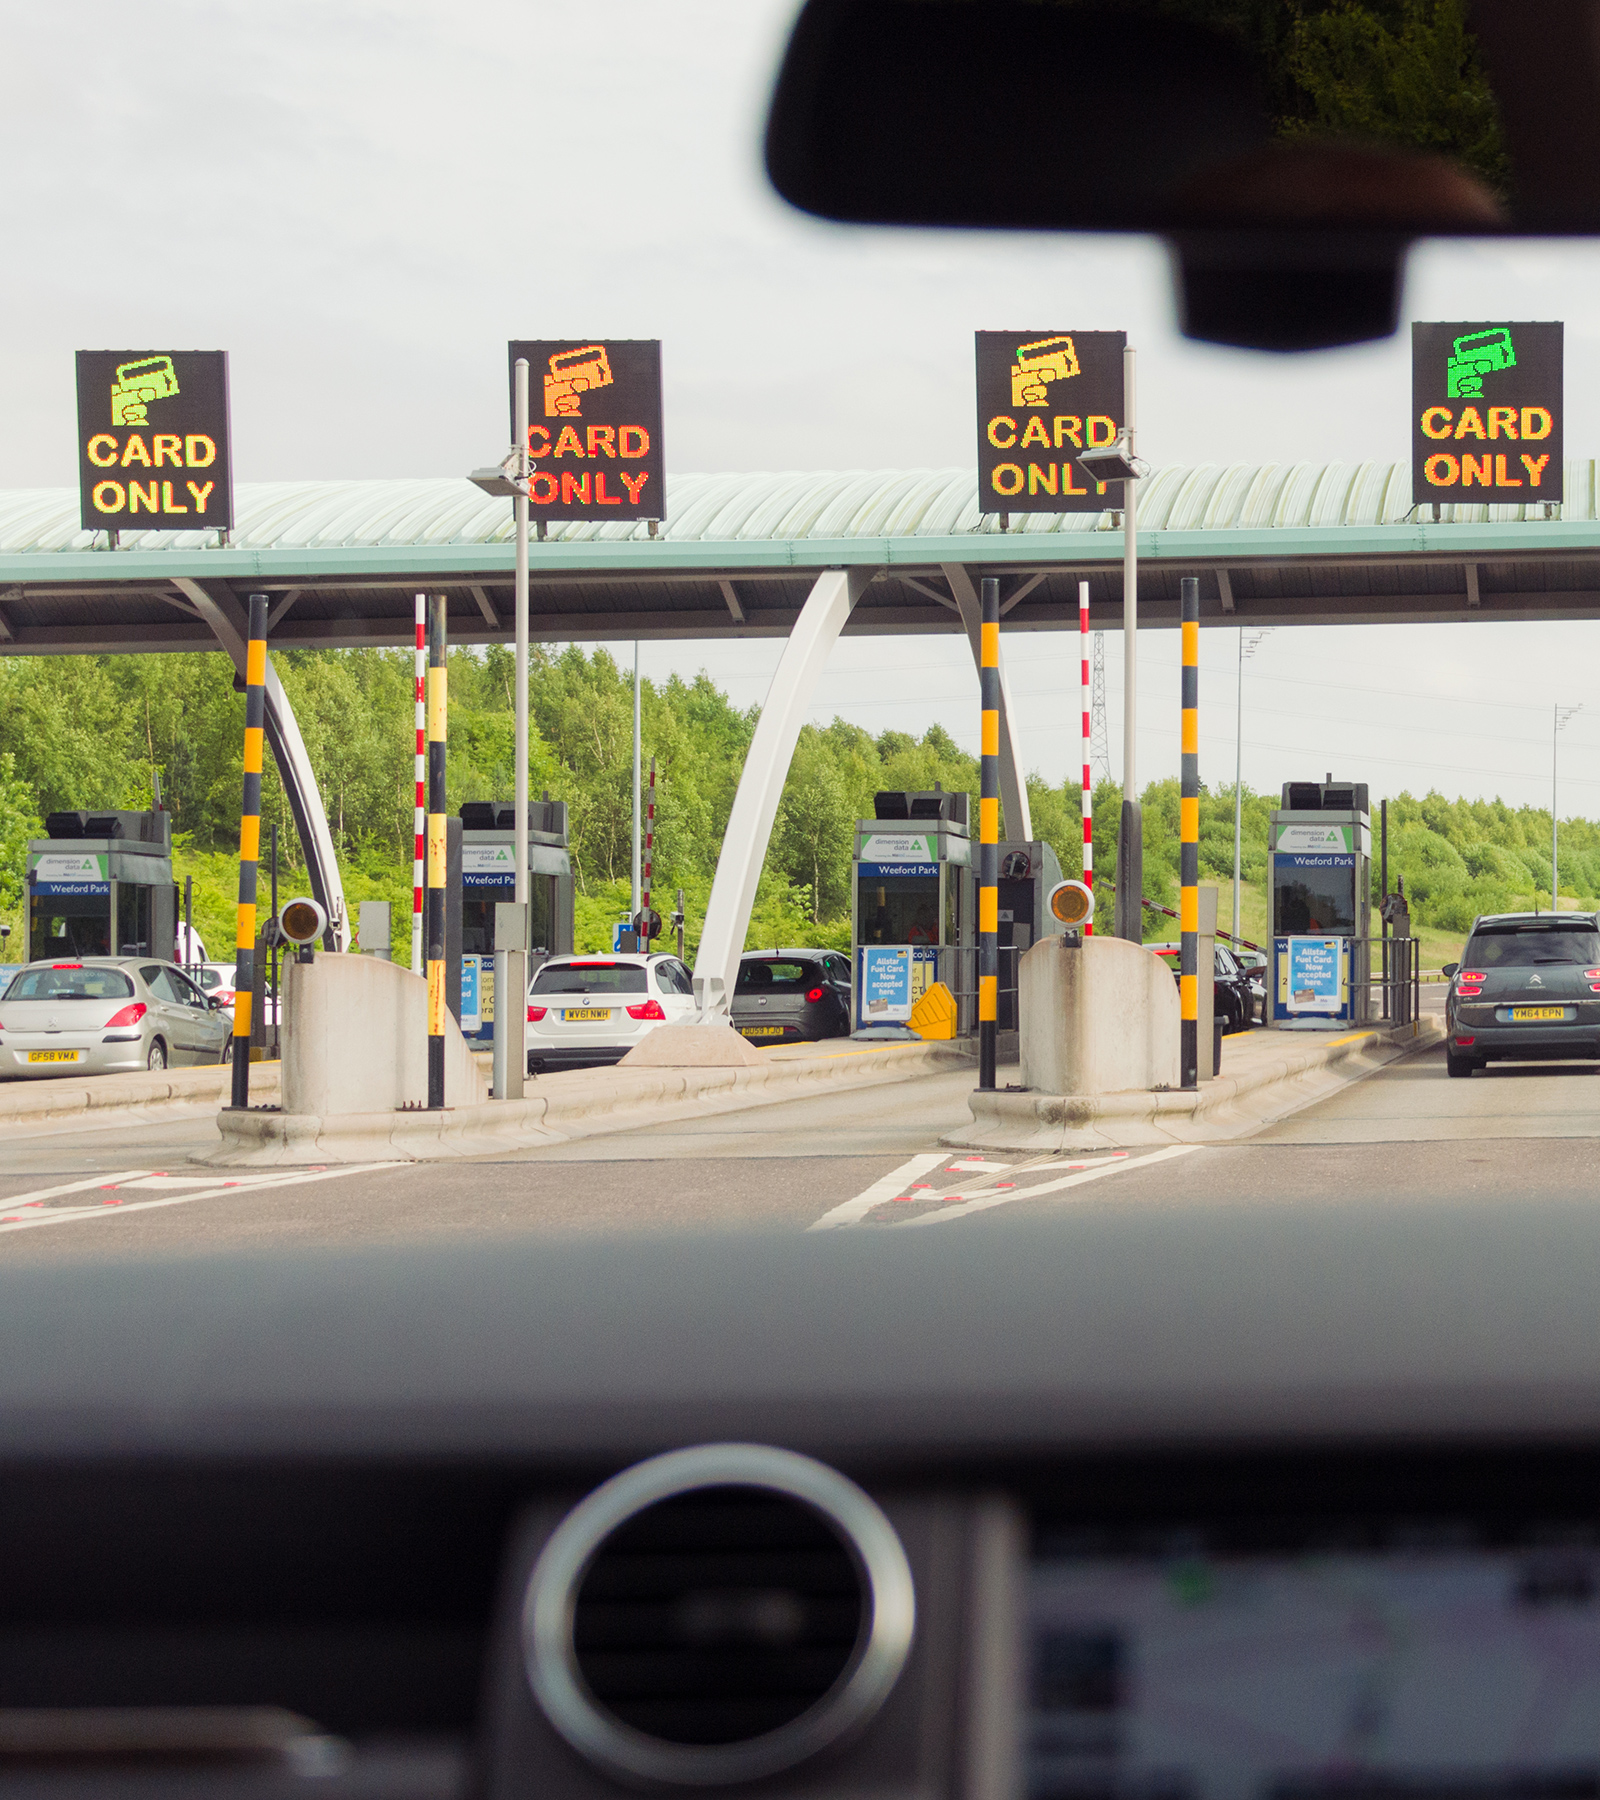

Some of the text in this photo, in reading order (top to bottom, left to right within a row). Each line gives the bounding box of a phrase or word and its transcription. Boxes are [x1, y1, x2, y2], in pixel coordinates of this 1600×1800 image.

[1420, 406, 1554, 440] CARD
[987, 414, 1117, 449] CARD
[528, 424, 651, 459] CARD
[87, 433, 218, 468] CARD
[1424, 453, 1551, 487] ONLY
[527, 471, 649, 505] ONLY
[92, 479, 216, 514] ONLY
[1294, 856, 1354, 866] Weeford Park
[878, 866, 938, 874] Weeford Park
[464, 876, 516, 884] Weeford Pa
[50, 884, 109, 893] Weeford Park
[1302, 948, 1327, 956] Allstar
[886, 965, 905, 973] Card.
[1297, 971, 1332, 979] accepted
[872, 980, 903, 988] accepted
[1304, 978, 1323, 986] here.
[569, 1010, 608, 1018] WV61 NWH
[1514, 1008, 1562, 1018] YM64 EPN
[31, 1052, 75, 1061] GF58 VMA
